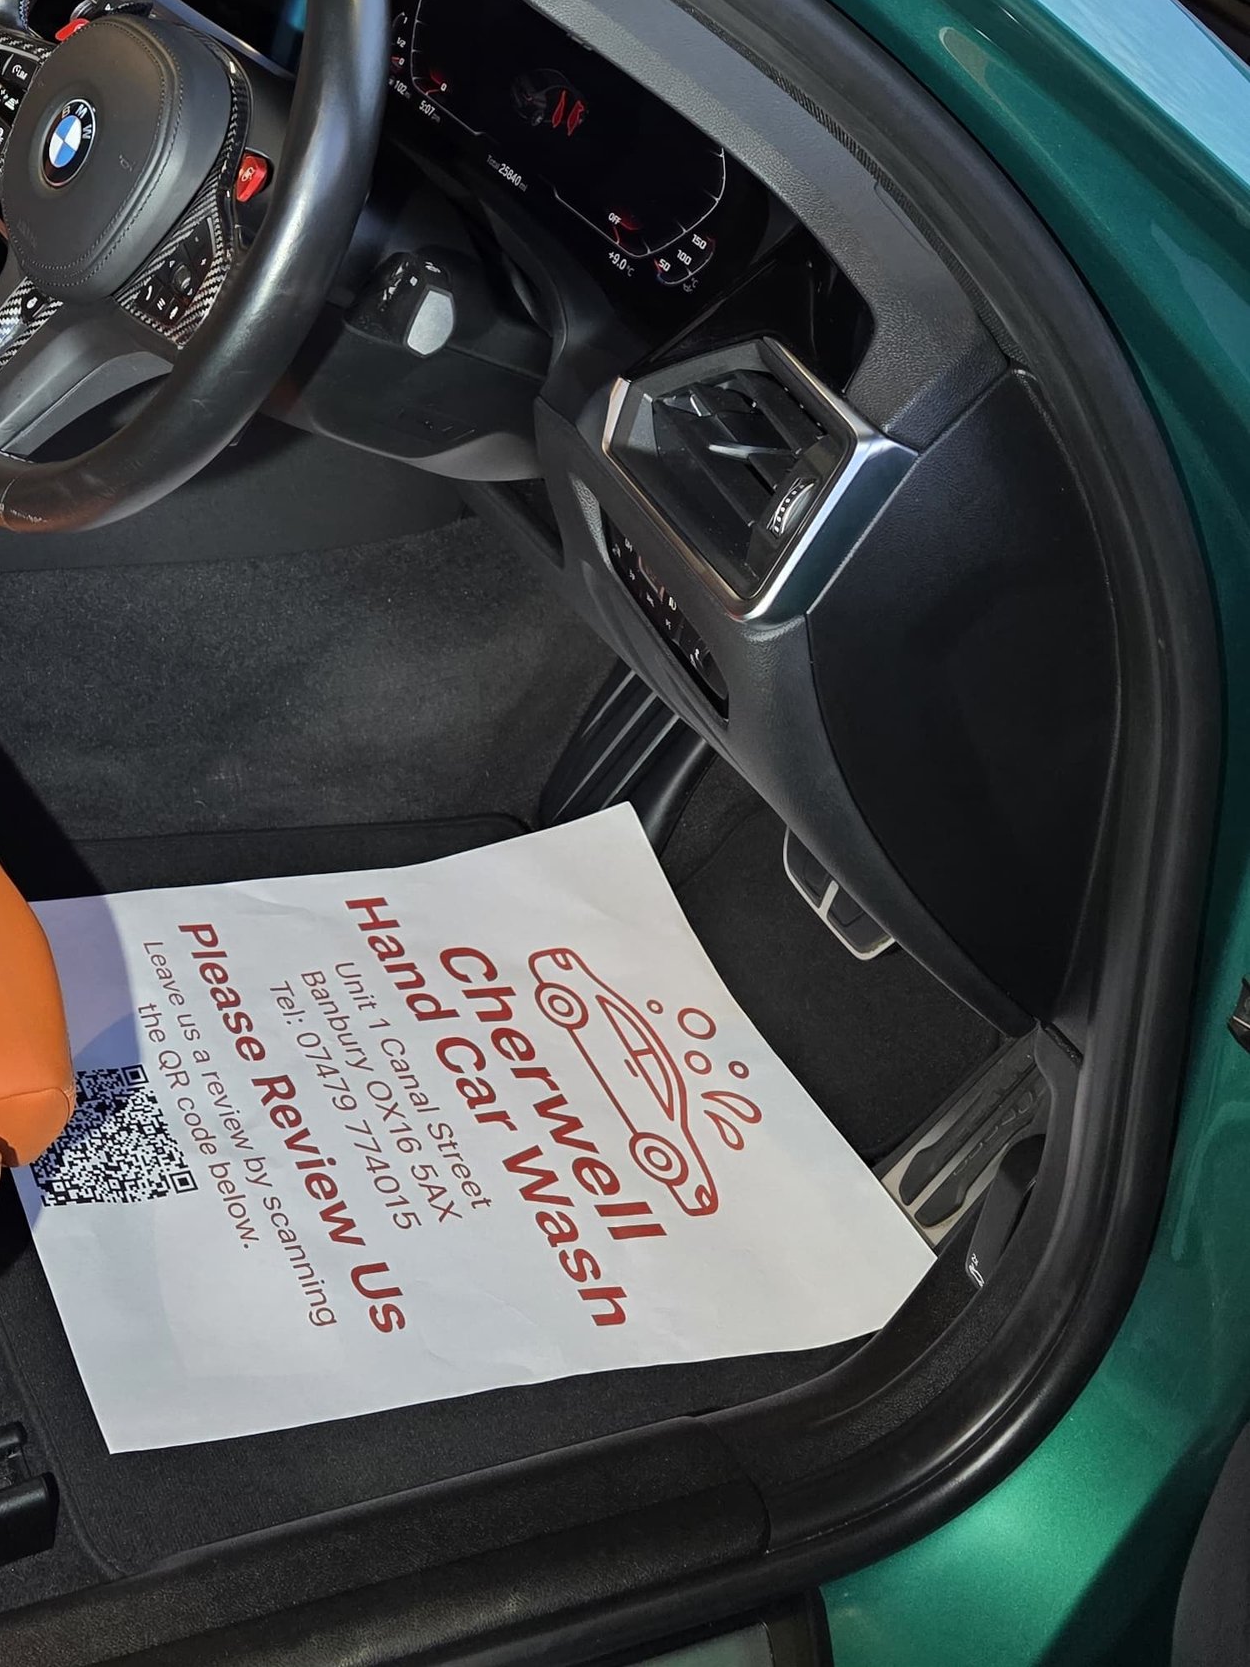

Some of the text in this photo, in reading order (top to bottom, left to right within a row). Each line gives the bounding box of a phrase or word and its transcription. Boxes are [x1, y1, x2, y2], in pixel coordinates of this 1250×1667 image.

[394, 80, 407, 95] 102
[62, 104, 93, 140] BMW
[419, 100, 436, 116] 5:07
[498, 163, 522, 186] 25840
[608, 212, 622, 225] OFF
[676, 249, 692, 266] 100
[691, 233, 707, 250] 150
[608, 251, 627, 270] +9.0
[658, 258, 671, 272] 50
[301, 971, 462, 1223] Banbury OX16 5AX
[335, 963, 492, 1209] Unit 1 Canal Street
[440, 947, 667, 1240] Cherwell
[270, 981, 422, 1229] Tel: 07479 774015
[345, 897, 627, 1326] Hand Car Wash
[139, 1003, 259, 1248] the QR code below.
[144, 942, 337, 1326] Leave us a review by scanning
[178, 924, 405, 1333] Please Review Us
